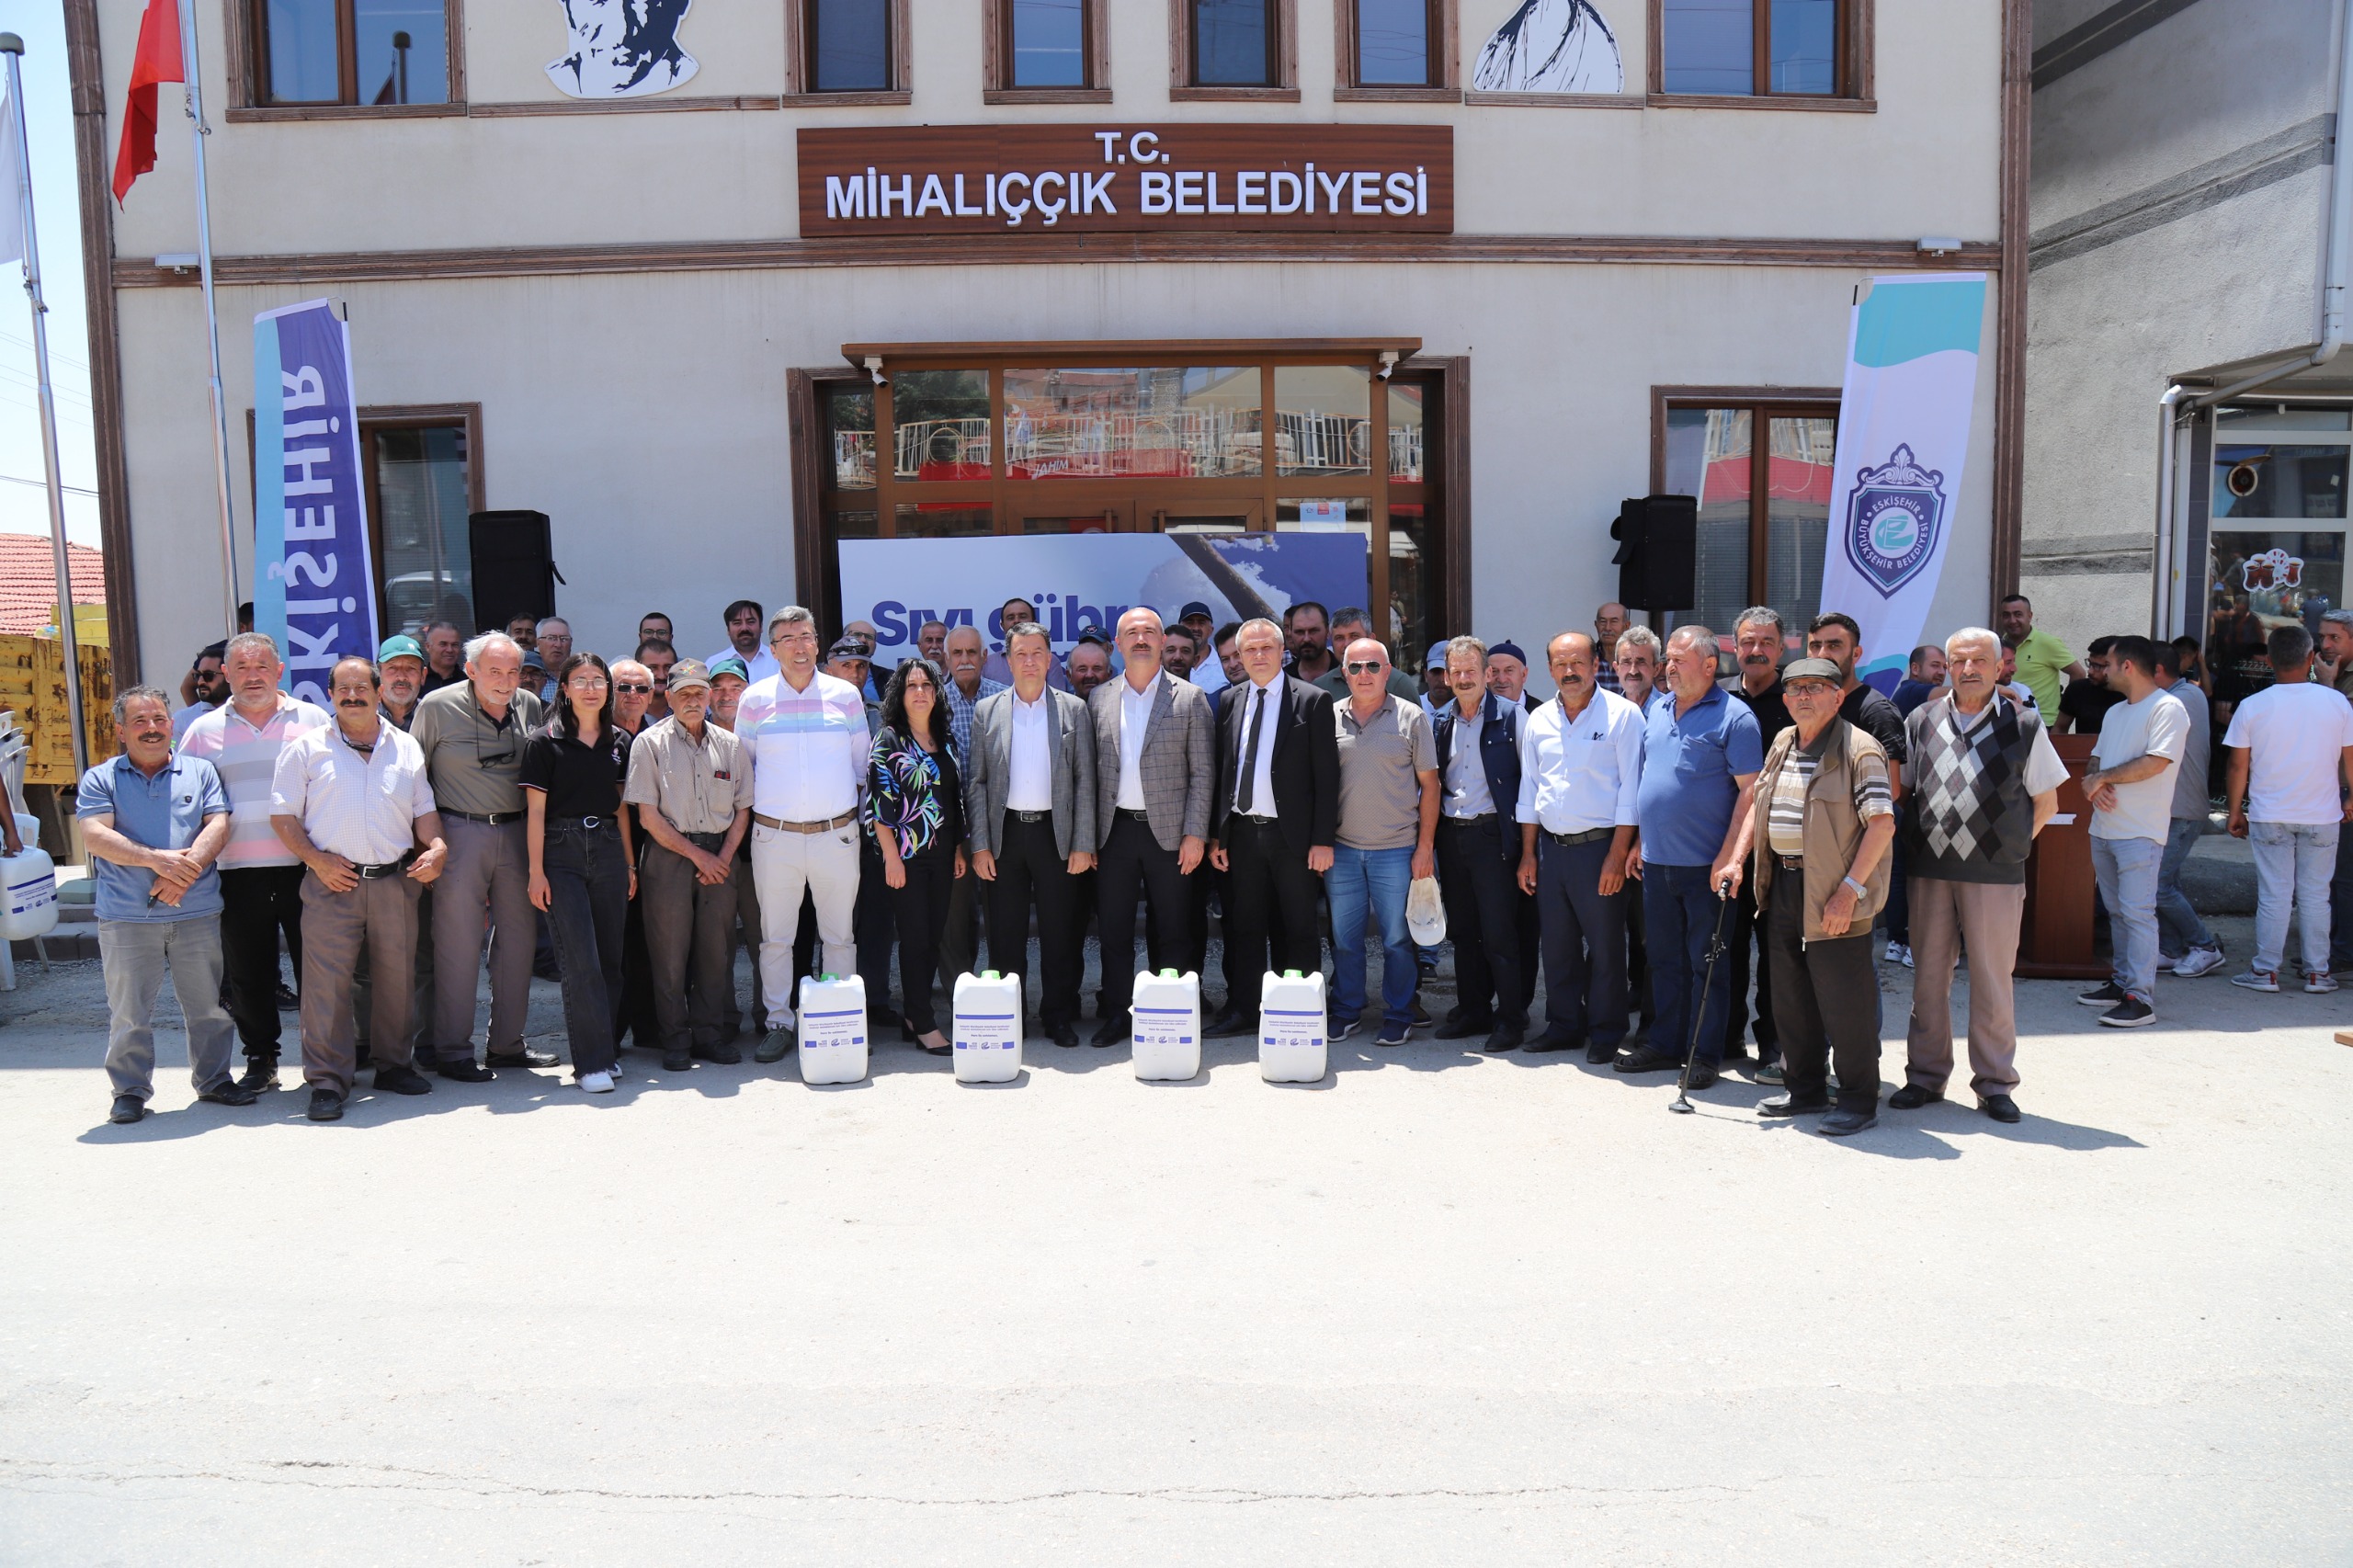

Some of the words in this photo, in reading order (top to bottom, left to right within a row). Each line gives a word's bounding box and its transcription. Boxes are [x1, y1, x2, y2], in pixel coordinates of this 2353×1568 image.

[1095, 131, 1170, 164] T.C.
[826, 166, 1117, 226] MİHALIÇÇIK
[1140, 163, 1428, 217] BELEDİYESİ
[1871, 494, 1921, 515] ESKİŞEHİR
[1859, 518, 1893, 569] BÜYÜKŞEHİR
